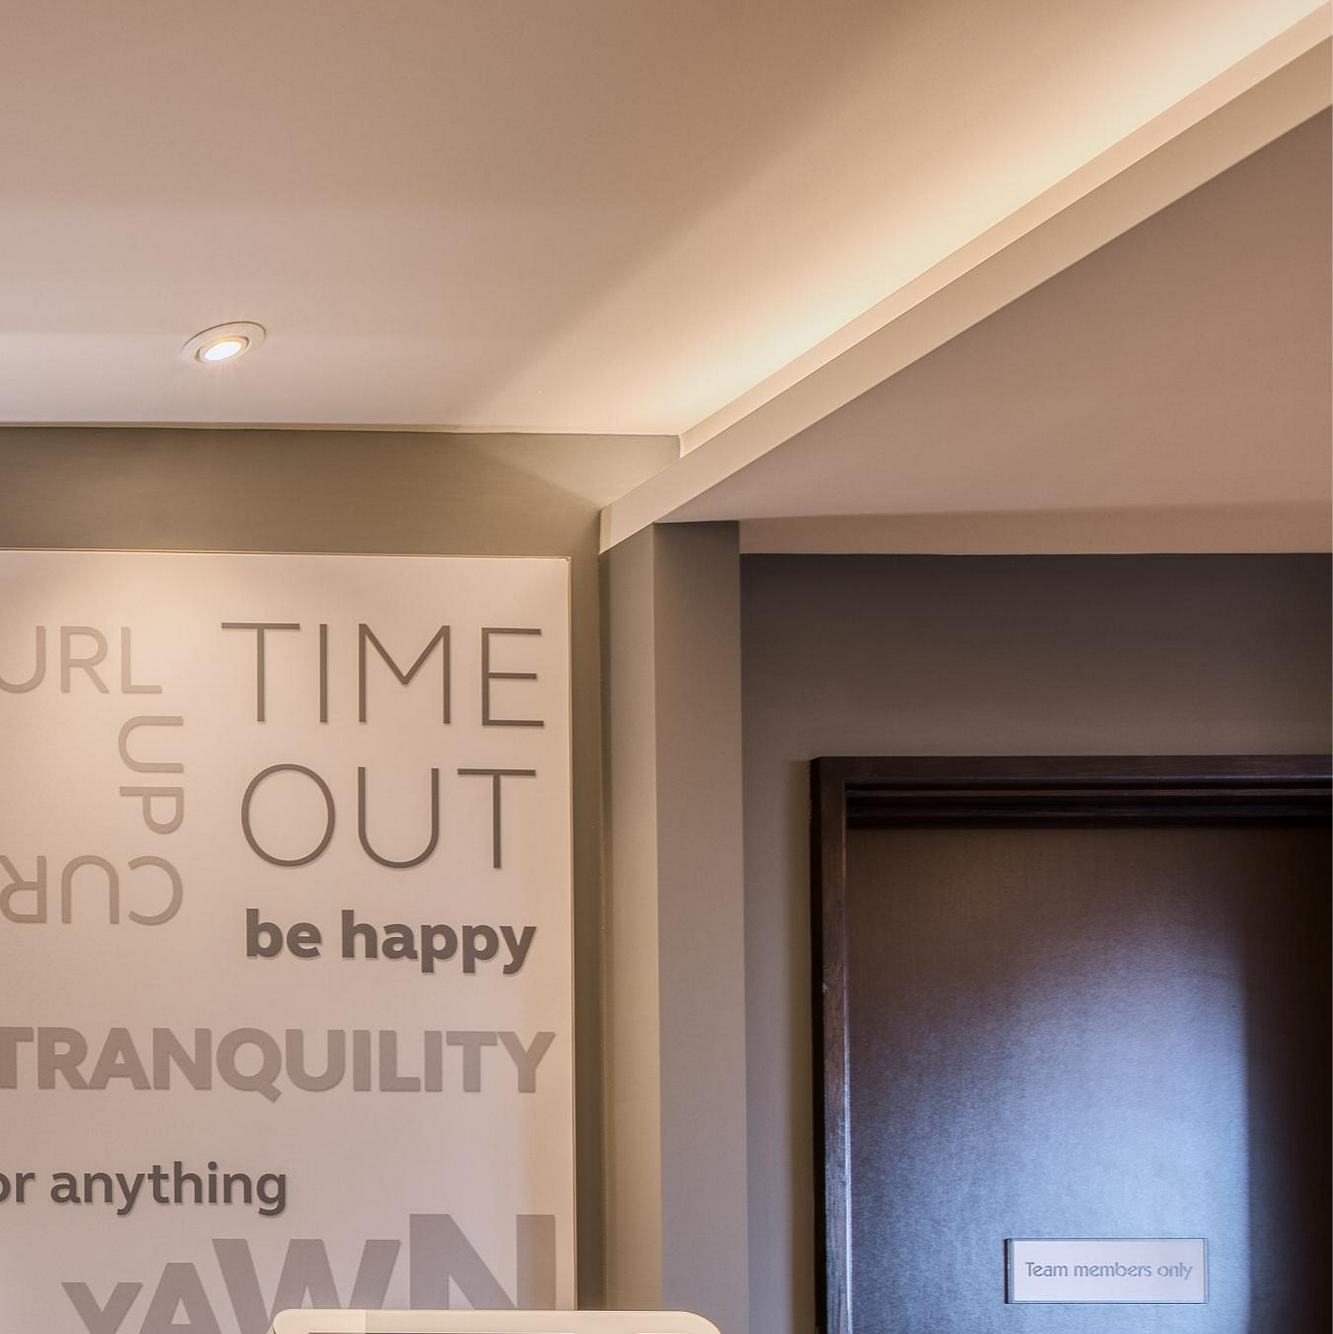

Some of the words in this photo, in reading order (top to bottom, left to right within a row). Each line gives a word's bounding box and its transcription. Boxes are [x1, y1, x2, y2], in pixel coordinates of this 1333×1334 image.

[221, 622, 544, 727] TIME
[119, 716, 184, 834] UP
[241, 763, 537, 869] OUT
[246, 909, 321, 959] be
[341, 909, 537, 974] happy
[50, 1161, 288, 1216] anything
[1025, 1262, 1068, 1277] Team
[1073, 1262, 1152, 1277] members
[1157, 1262, 1193, 1280] only
